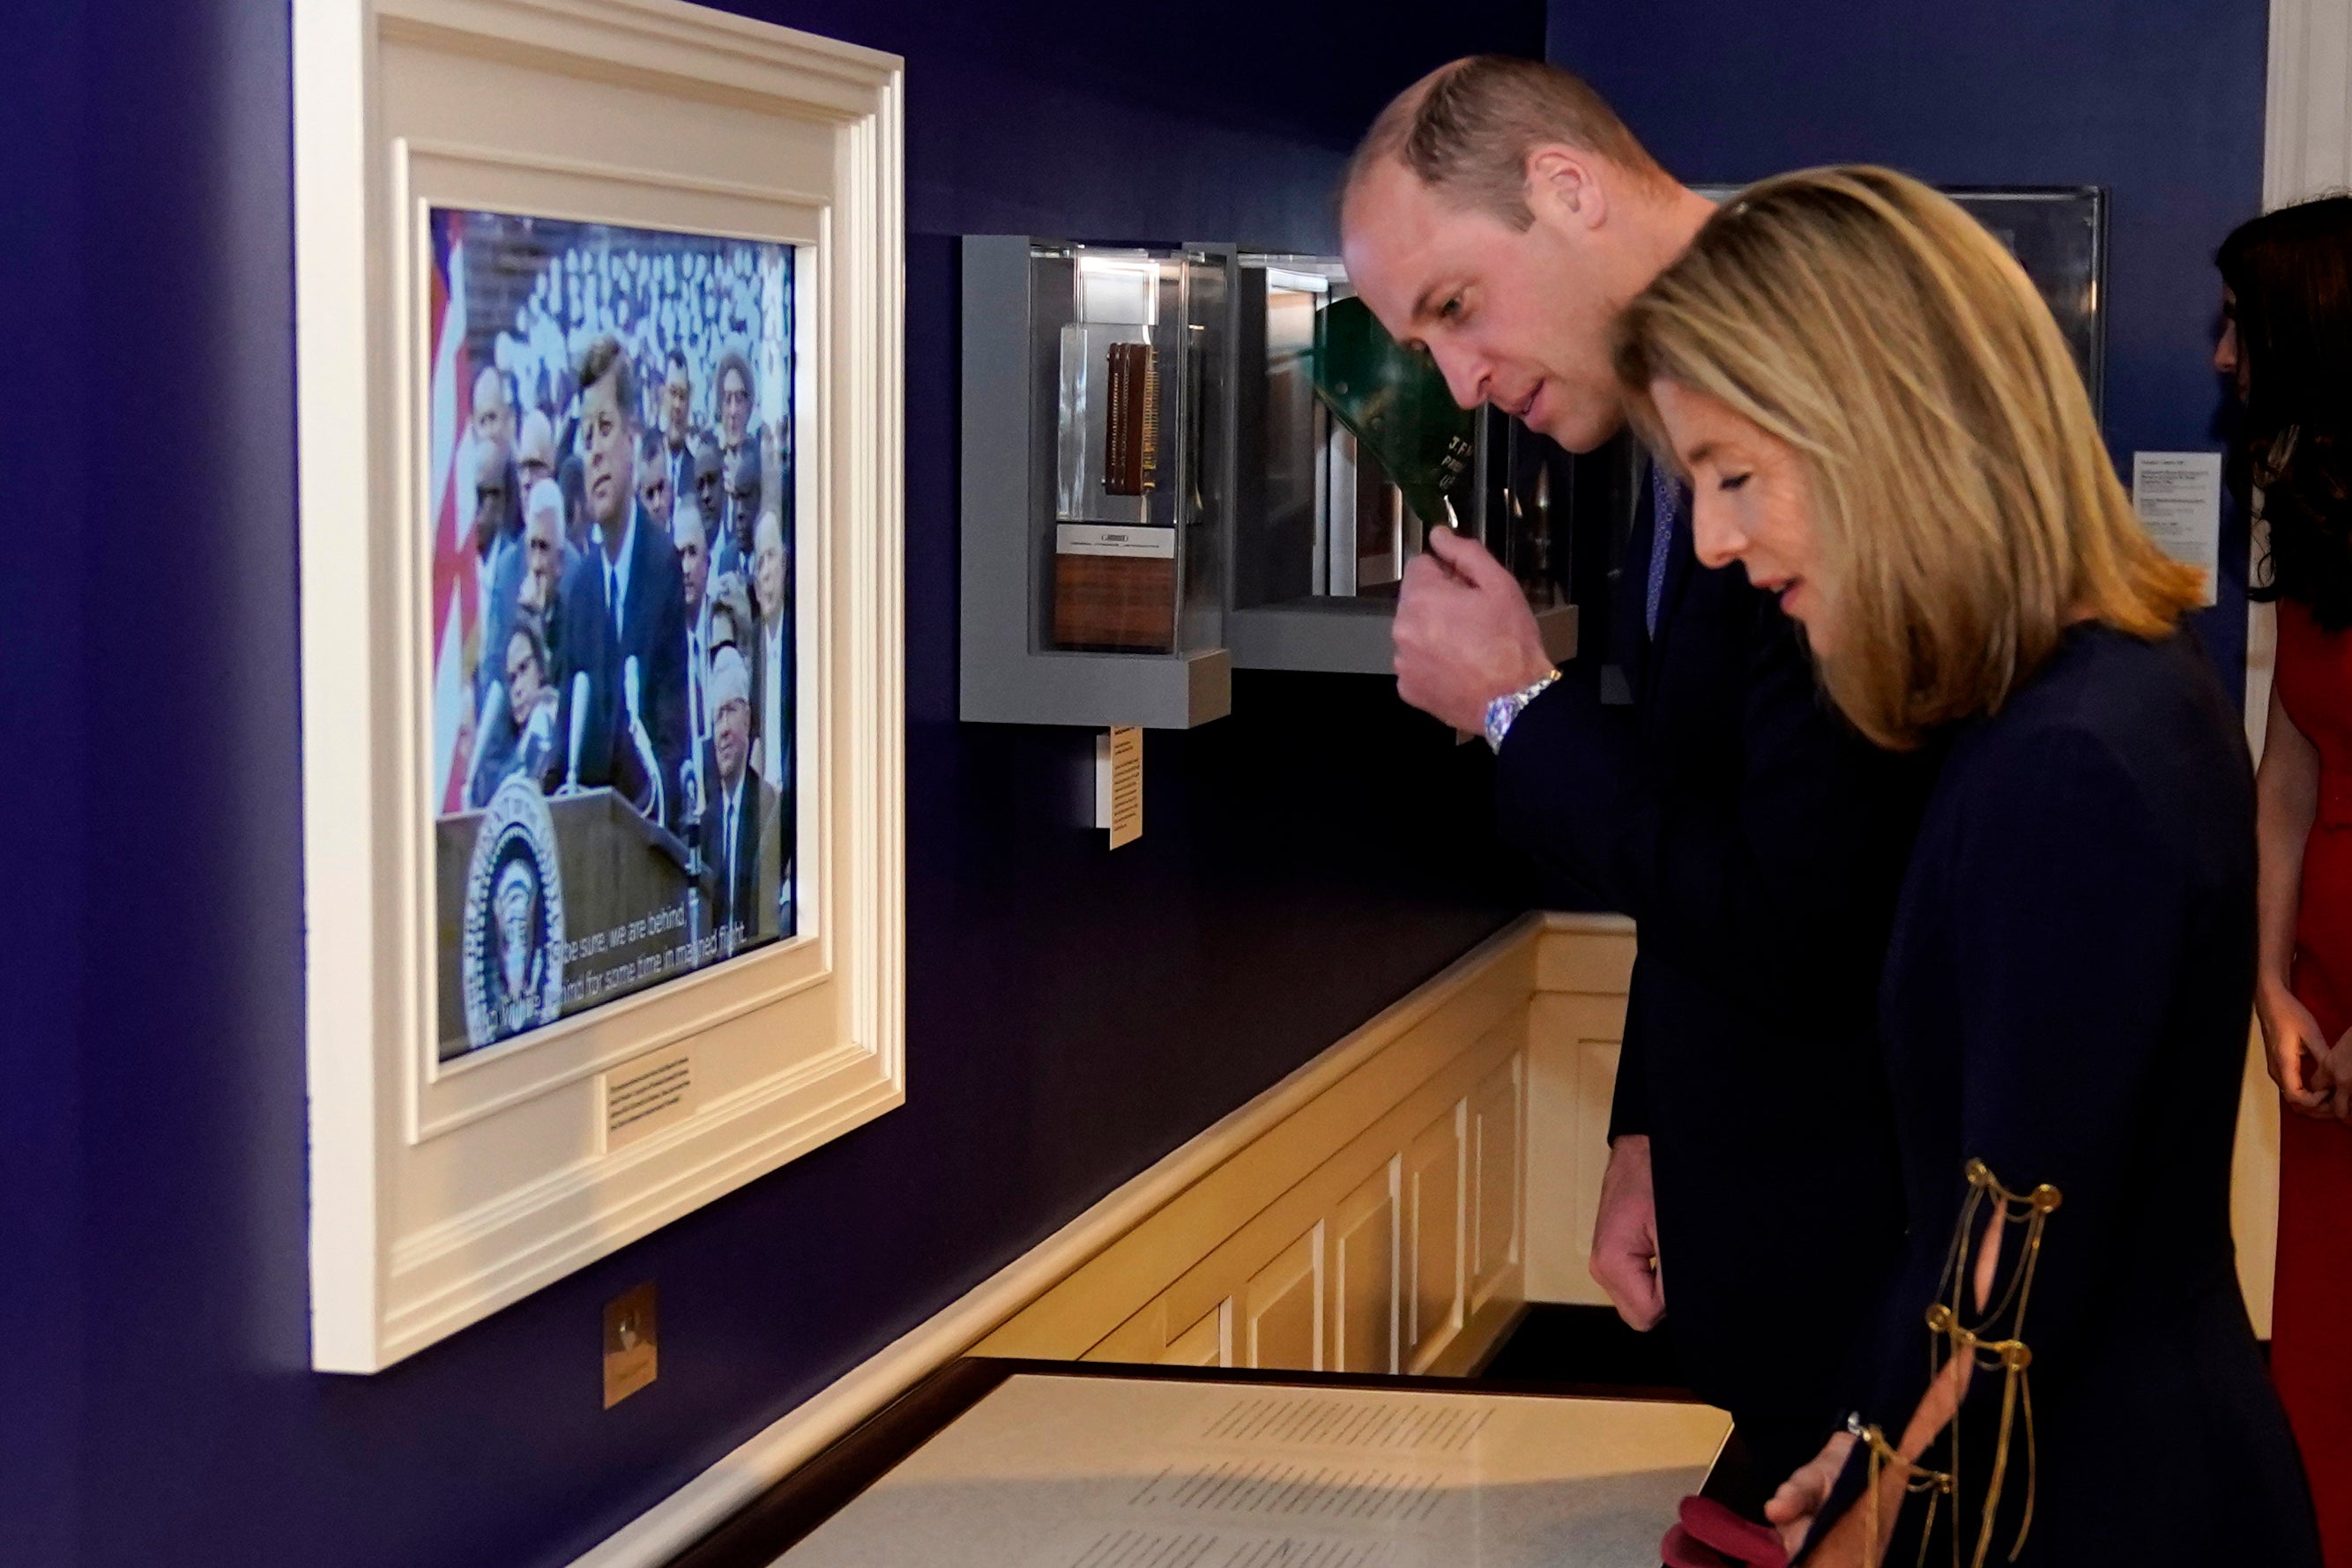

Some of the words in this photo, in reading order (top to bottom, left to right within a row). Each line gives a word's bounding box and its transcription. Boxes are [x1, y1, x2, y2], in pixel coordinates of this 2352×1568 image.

[563, 938, 578, 964] be
[580, 932, 608, 958] sure,
[608, 925, 627, 947] we
[628, 919, 646, 942] are
[647, 902, 688, 935] behind,
[586, 970, 603, 996] for
[605, 961, 636, 986] some
[636, 953, 661, 978] time
[663, 945, 675, 969] in
